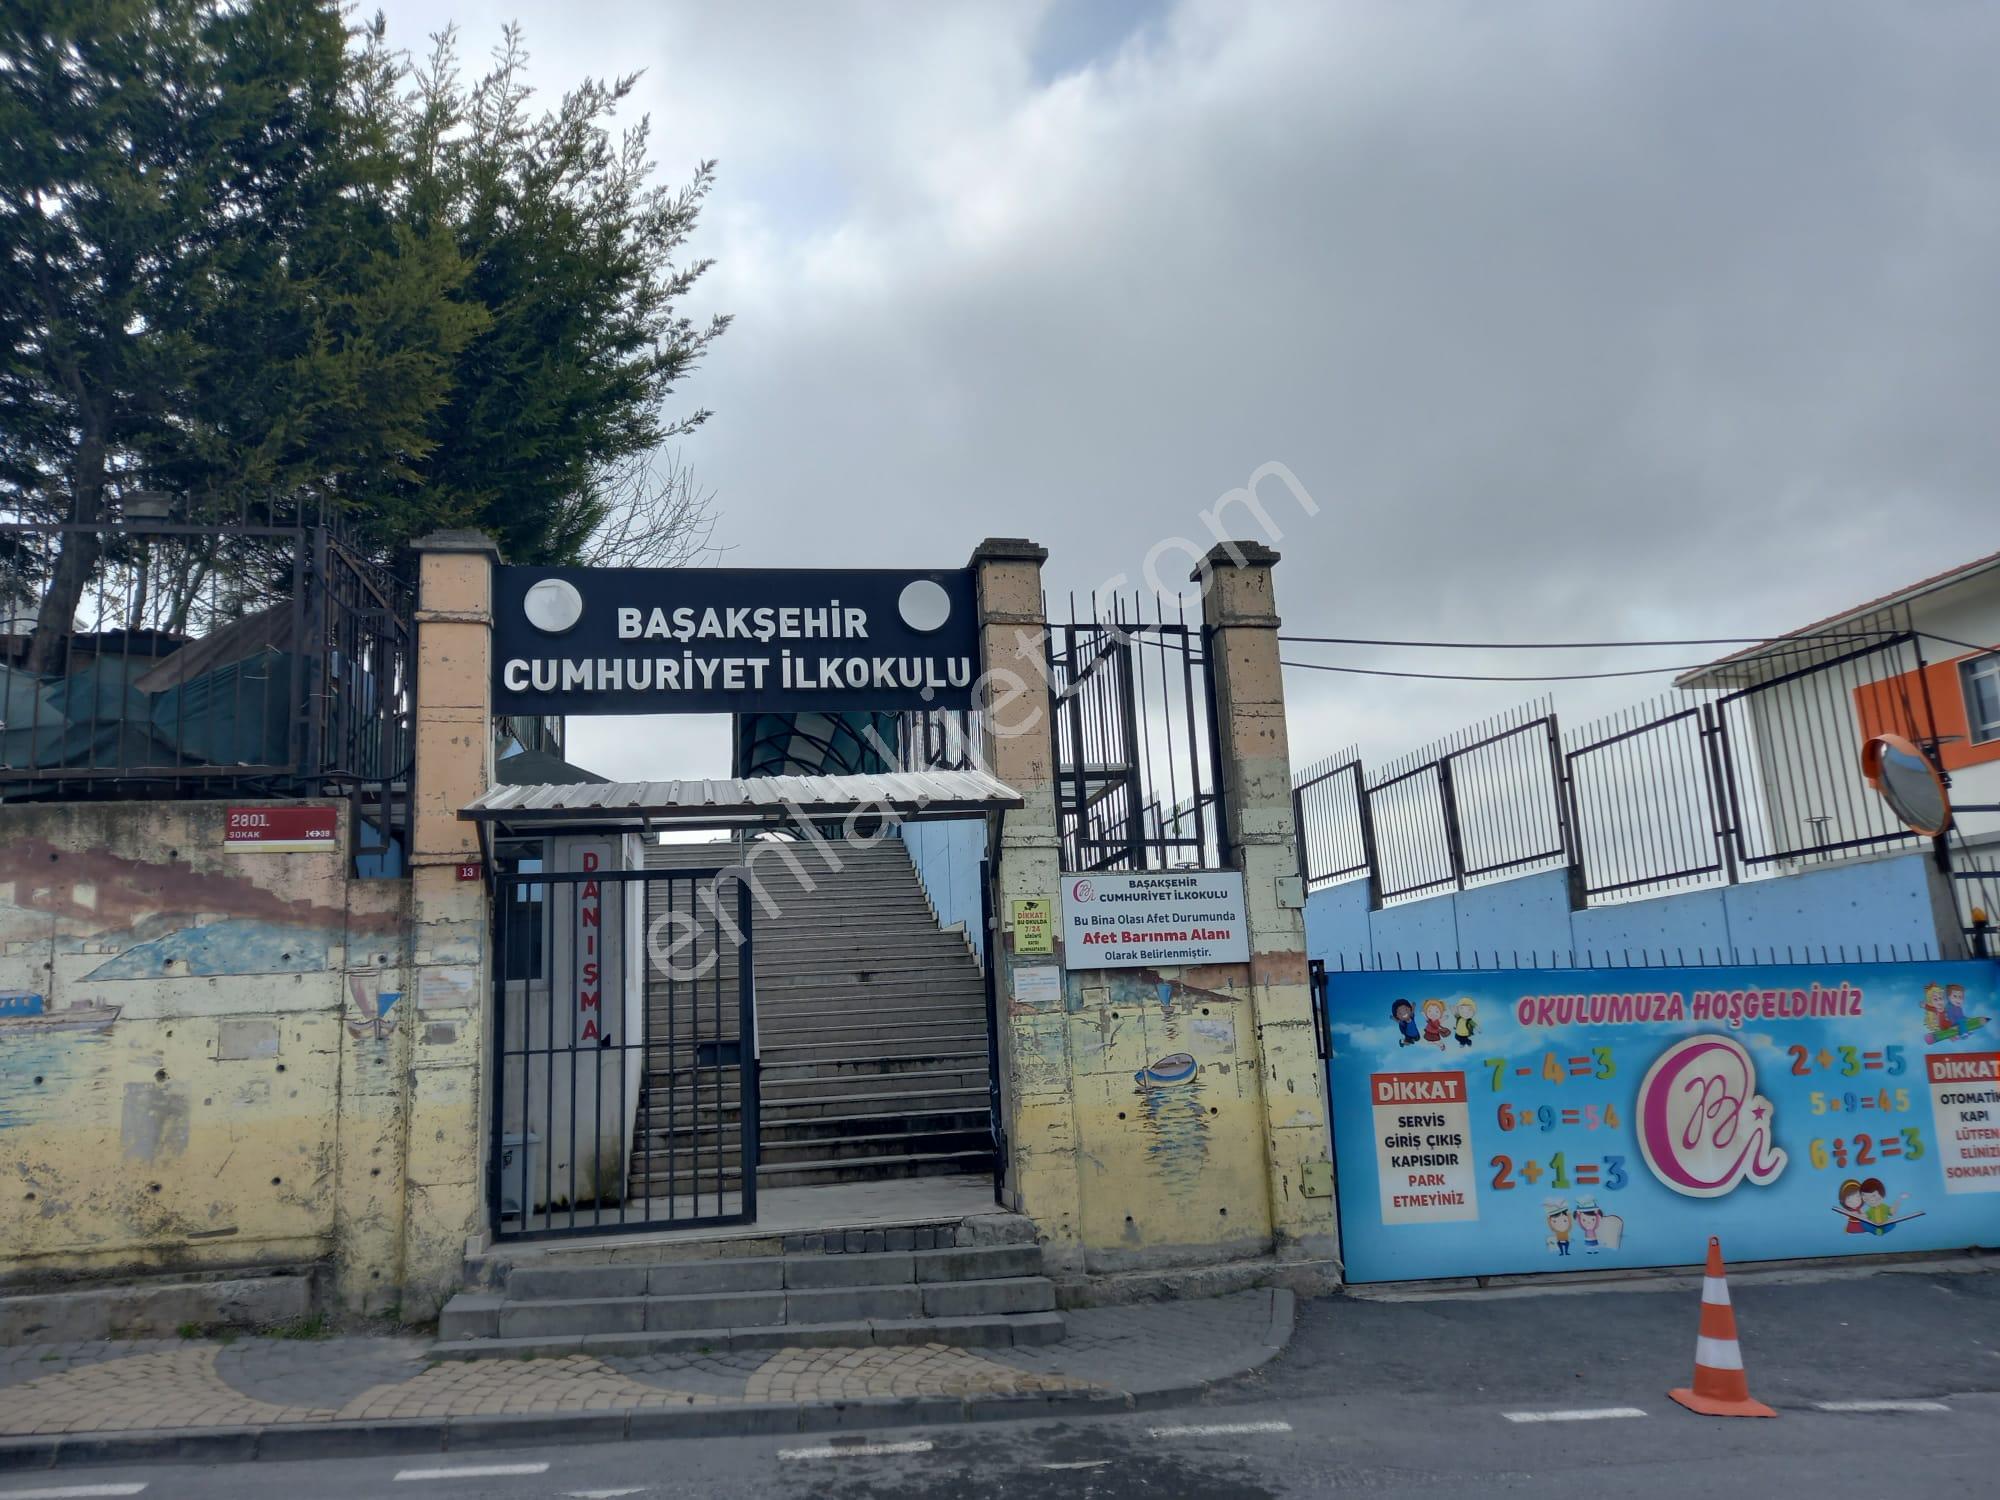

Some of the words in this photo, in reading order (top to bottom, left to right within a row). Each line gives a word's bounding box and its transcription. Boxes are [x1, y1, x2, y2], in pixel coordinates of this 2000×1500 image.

[617, 599, 869, 643] BAŞAKŞEHİR
[503, 650, 770, 692] CUMHURİYET
[782, 649, 971, 689] İLKOKULU
[231, 814, 271, 827] 2801.
[229, 831, 260, 839] SOKAK
[463, 867, 473, 877] 13
[1129, 877, 1197, 890] BAŞAKŞEHİR
[1100, 891, 1171, 903] CUMHURİYET
[1174, 889, 1228, 901] İLKOKULU
[1074, 916, 1089, 926] Bu
[1091, 914, 1115, 925] Bina
[1117, 914, 1145, 925] Olası
[1146, 912, 1170, 924] Afet
[1172, 911, 1236, 923] Durumunda
[1083, 932, 1118, 945] Afet
[1121, 930, 1188, 943] Barınma
[1190, 928, 1231, 941] Alanı
[581, 852, 600, 1041] DANIŞMA
[1104, 950, 1138, 961] Olarak
[1140, 947, 1212, 961] Belirlenmiştir.
[1518, 995, 1684, 1026] OKULUMUZA
[1693, 983, 1863, 1026] HOŞGELDİNİZ
[1932, 1057, 2000, 1080] DİKKAT
[1378, 1077, 1458, 1102] DİKKAT
[1398, 1112, 1445, 1128] SERVİS
[1960, 1110, 1989, 1122] KAPI
[1384, 1132, 1421, 1150] GİRİŞ
[1426, 1133, 1462, 1150] ÇIKIŞ
[1956, 1127, 2000, 1141] LÜTFEN
[1391, 1154, 1459, 1168] KAPISIDIR
[1408, 1174, 1446, 1187] PARK
[1393, 1190, 1464, 1208] ETMEYİNİZ
